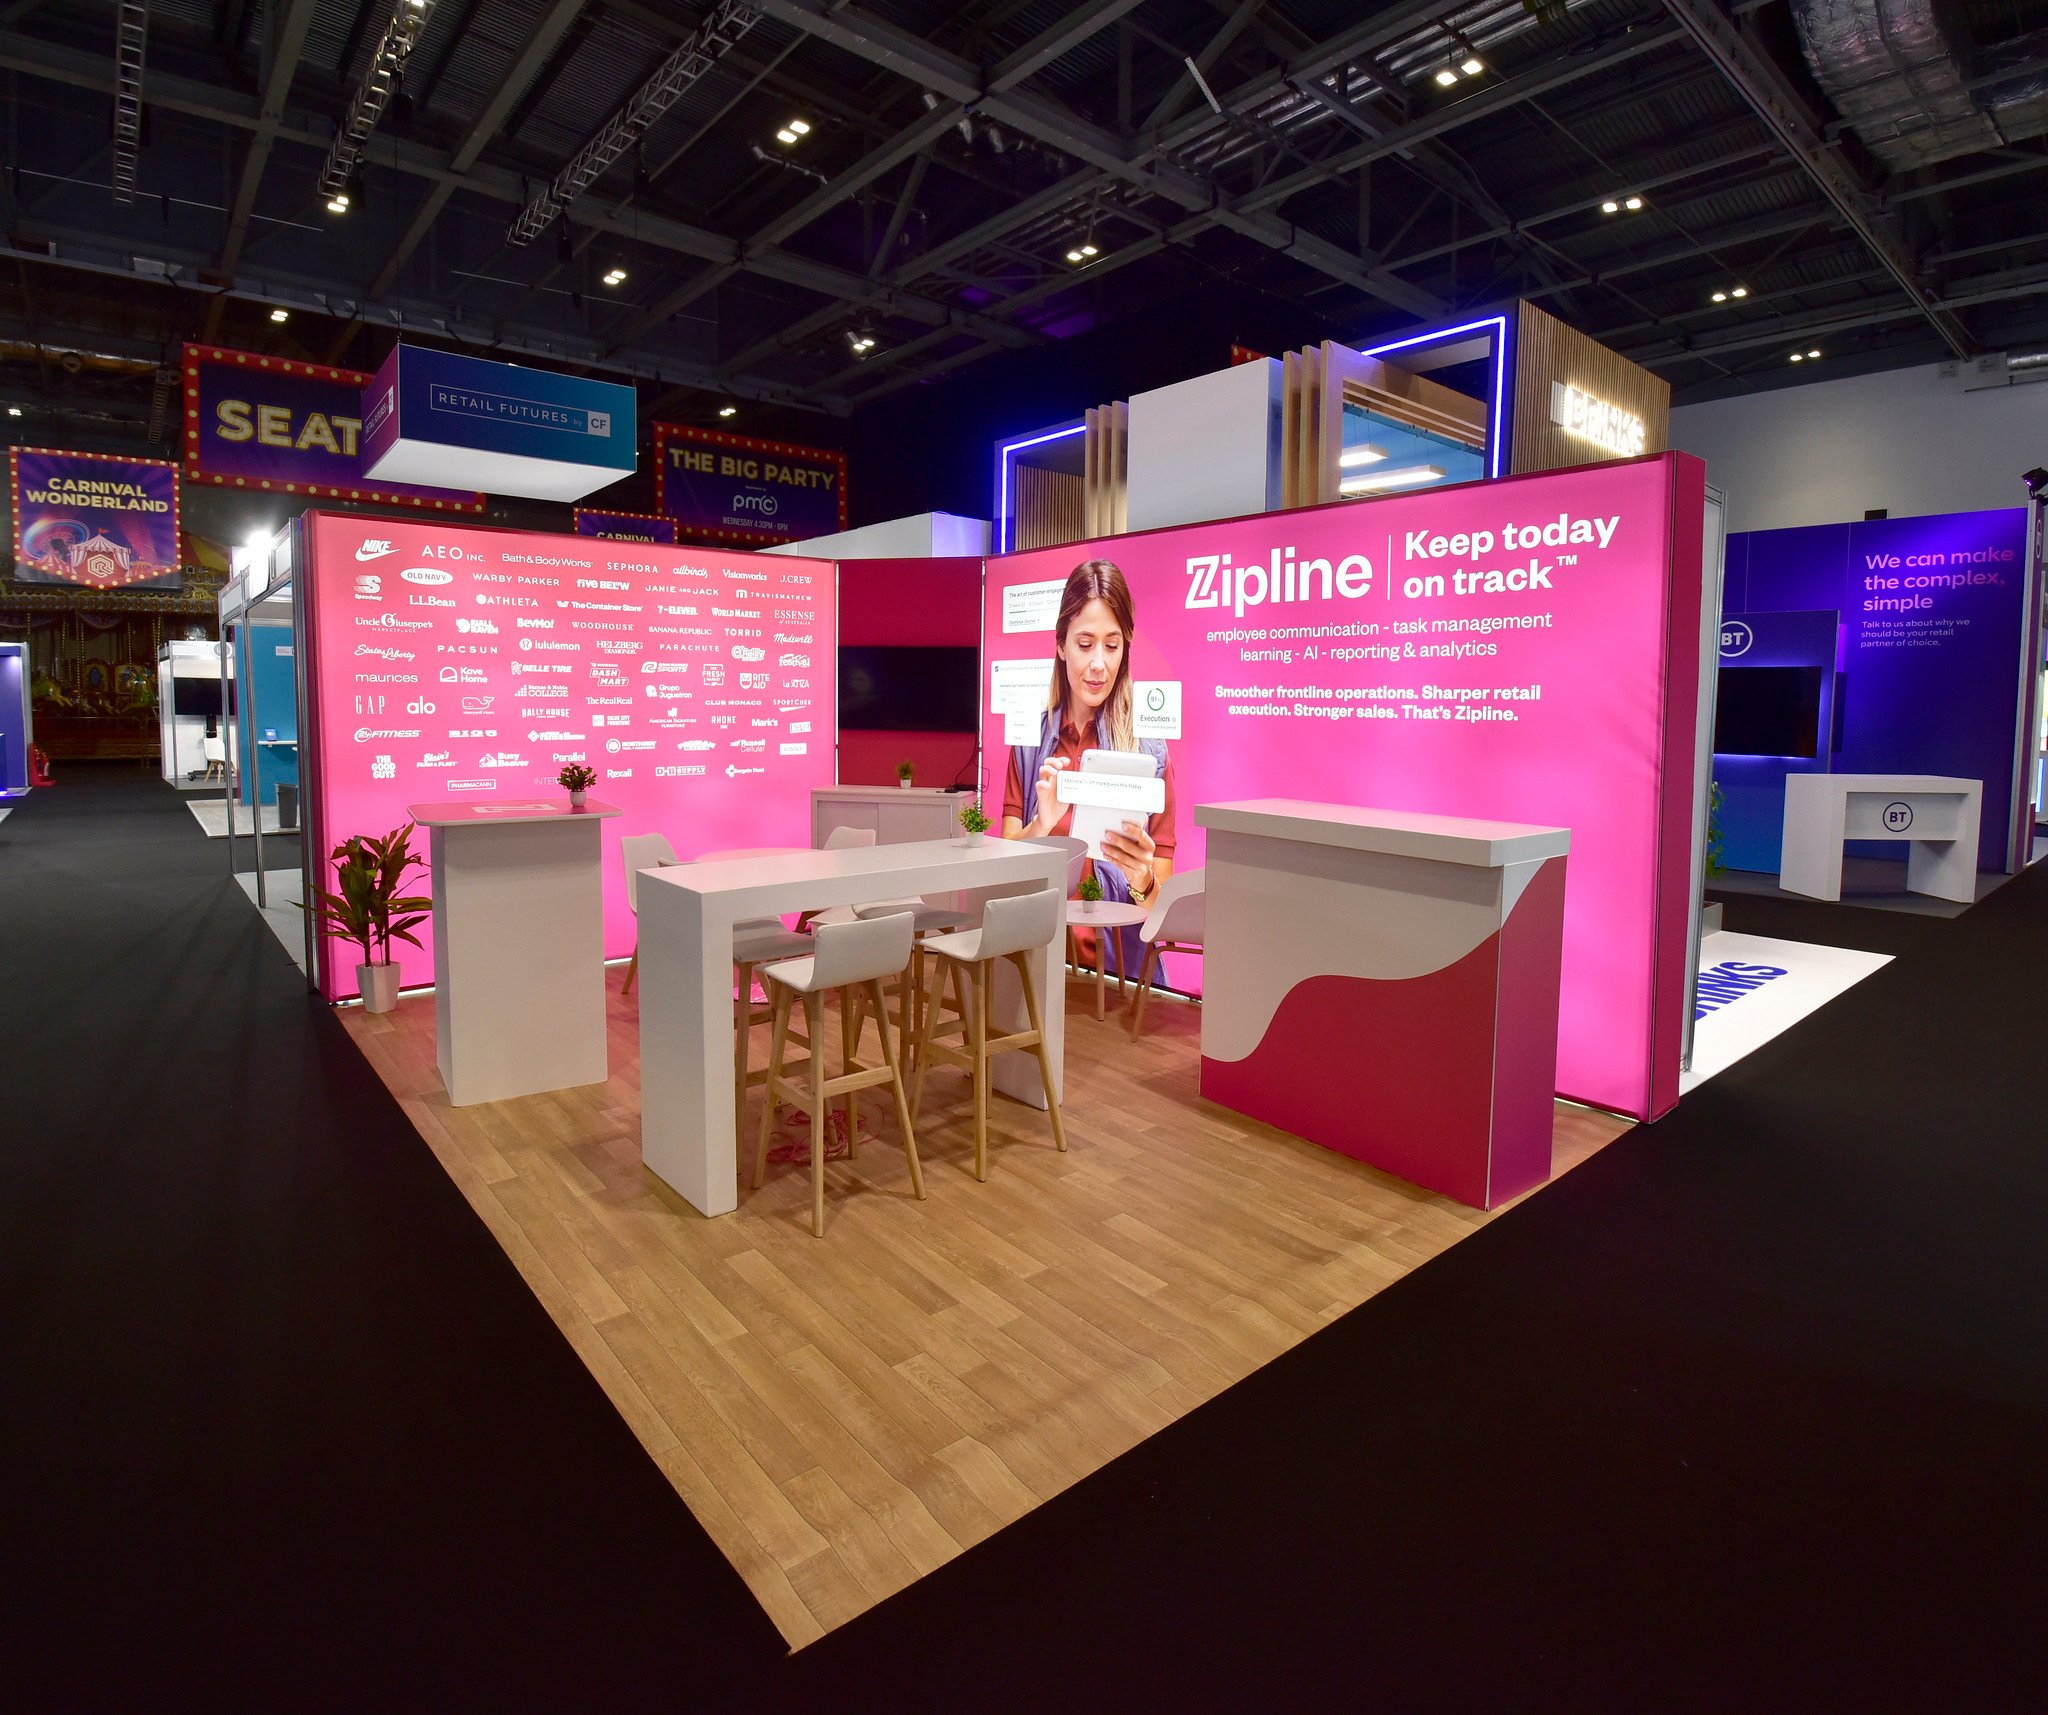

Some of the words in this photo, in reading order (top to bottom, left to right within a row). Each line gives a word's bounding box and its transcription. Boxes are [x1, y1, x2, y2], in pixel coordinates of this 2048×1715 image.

[439, 392, 494, 411] RETAIL
[500, 403, 568, 423] FUTURES
[573, 418, 583, 426] by
[590, 418, 606, 430] CF
[669, 447, 714, 473] THE
[721, 456, 758, 480] BIG
[764, 463, 835, 490] PARTY
[47, 477, 147, 498] CARNIVAL
[25, 489, 169, 513] WONDERLAND
[733, 494, 778, 515] pmc
[722, 516, 754, 527] WEDNESDAY
[1404, 529, 1494, 561] Keep
[1502, 513, 1621, 551] today
[362, 539, 391, 552] NIKE
[421, 545, 463, 560] AEO
[466, 554, 486, 562] INC.
[1865, 553, 1900, 570] We
[1905, 554, 1945, 567] can
[1951, 546, 2015, 565] make
[502, 553, 526, 563] Bath
[526, 555, 534, 564] &
[535, 556, 560, 567] Body
[561, 558, 592, 568] Works
[607, 562, 659, 573] SEPHORA
[672, 565, 708, 579] allbirds
[407, 571, 423, 580] OLD
[424, 573, 447, 581] NAVY
[473, 573, 512, 583] WARBY
[517, 576, 560, 586] PARKER
[722, 568, 768, 581] Visionworks
[780, 575, 812, 585] J.CREW
[1864, 575, 1899, 590] the
[1903, 570, 2005, 590] complex,
[1184, 546, 1373, 618] Zipline
[1403, 574, 1445, 599] on
[645, 584, 676, 593] JANIE
[693, 588, 719, 596] JACK
[354, 593, 382, 601] Speedway
[409, 595, 456, 607] L.L.Bean
[487, 595, 539, 607] ATHLETA
[572, 601, 586, 609] The
[586, 602, 622, 611] Container
[1863, 594, 1934, 613] simple
[774, 609, 815, 620] ESSENSE
[355, 617, 380, 626] Uncle
[381, 612, 433, 629] Giuseppe's
[516, 618, 555, 629] BevMo!
[572, 621, 634, 631] WOODHOUSE
[1862, 621, 1880, 629] Talk
[1905, 620, 1933, 628] about
[1935, 619, 1954, 628] why
[648, 625, 678, 635] BANANA
[679, 627, 713, 636] REPUBLIC
[724, 628, 762, 637] TORRID
[1206, 627, 1267, 644] employee
[1269, 620, 1379, 640] communication
[1393, 617, 1428, 635] task
[1431, 612, 1552, 635] management
[1861, 630, 1891, 638] should
[1893, 630, 1905, 638] be
[1906, 631, 1928, 639] your
[1929, 628, 1954, 636] retail
[773, 632, 813, 644] Madewell
[1720, 632, 1744, 645] BT
[1860, 640, 1895, 649] partner
[1896, 639, 1906, 647] of
[1907, 638, 1941, 647] choice.
[437, 645, 497, 654] PACSUN
[534, 640, 580, 651] lululemon
[596, 640, 643, 649] HELZBERG
[659, 643, 720, 652] PARACHUTE
[1240, 647, 1292, 664] learning
[1303, 645, 1318, 660] AI
[1330, 643, 1400, 662] reporting
[1403, 641, 1416, 658] &
[1419, 640, 1498, 660] analytics
[460, 666, 483, 675] Kave
[522, 664, 549, 673] BELLE
[552, 665, 572, 673] TIRE
[592, 669, 618, 677] DASH
[355, 673, 418, 683] maurices
[460, 675, 488, 683] Home
[600, 677, 626, 685] MART
[752, 673, 770, 681] RITE
[659, 684, 680, 692] Grupo
[752, 681, 766, 689] AID
[1214, 685, 1274, 699] Smoother
[1276, 685, 1333, 699] frontline
[1335, 685, 1419, 701] operations.
[1421, 684, 1490, 702] Sharper
[1493, 684, 1542, 700] retail
[355, 695, 385, 715] GAP
[406, 696, 436, 714] alo
[545, 708, 571, 718] HOUSE
[1140, 714, 1170, 722] Execution
[1228, 703, 1291, 716] execution.
[1293, 703, 1354, 720] Stronger
[1356, 704, 1399, 718] sales.
[1401, 704, 1451, 720] That's
[1454, 705, 1519, 723] Zipline.
[711, 715, 736, 724] RHONE
[751, 718, 778, 727] Mark's
[371, 730, 421, 738] FITNESS
[375, 754, 391, 763] THE
[498, 752, 519, 760] Busy
[553, 752, 585, 762] Parallel
[371, 763, 396, 771] GOOD
[498, 759, 529, 767] Beaver
[373, 770, 395, 779] GUYS
[607, 768, 632, 779] Rexall
[450, 781, 492, 789] PHARMACANN
[1889, 811, 1907, 824] BT
